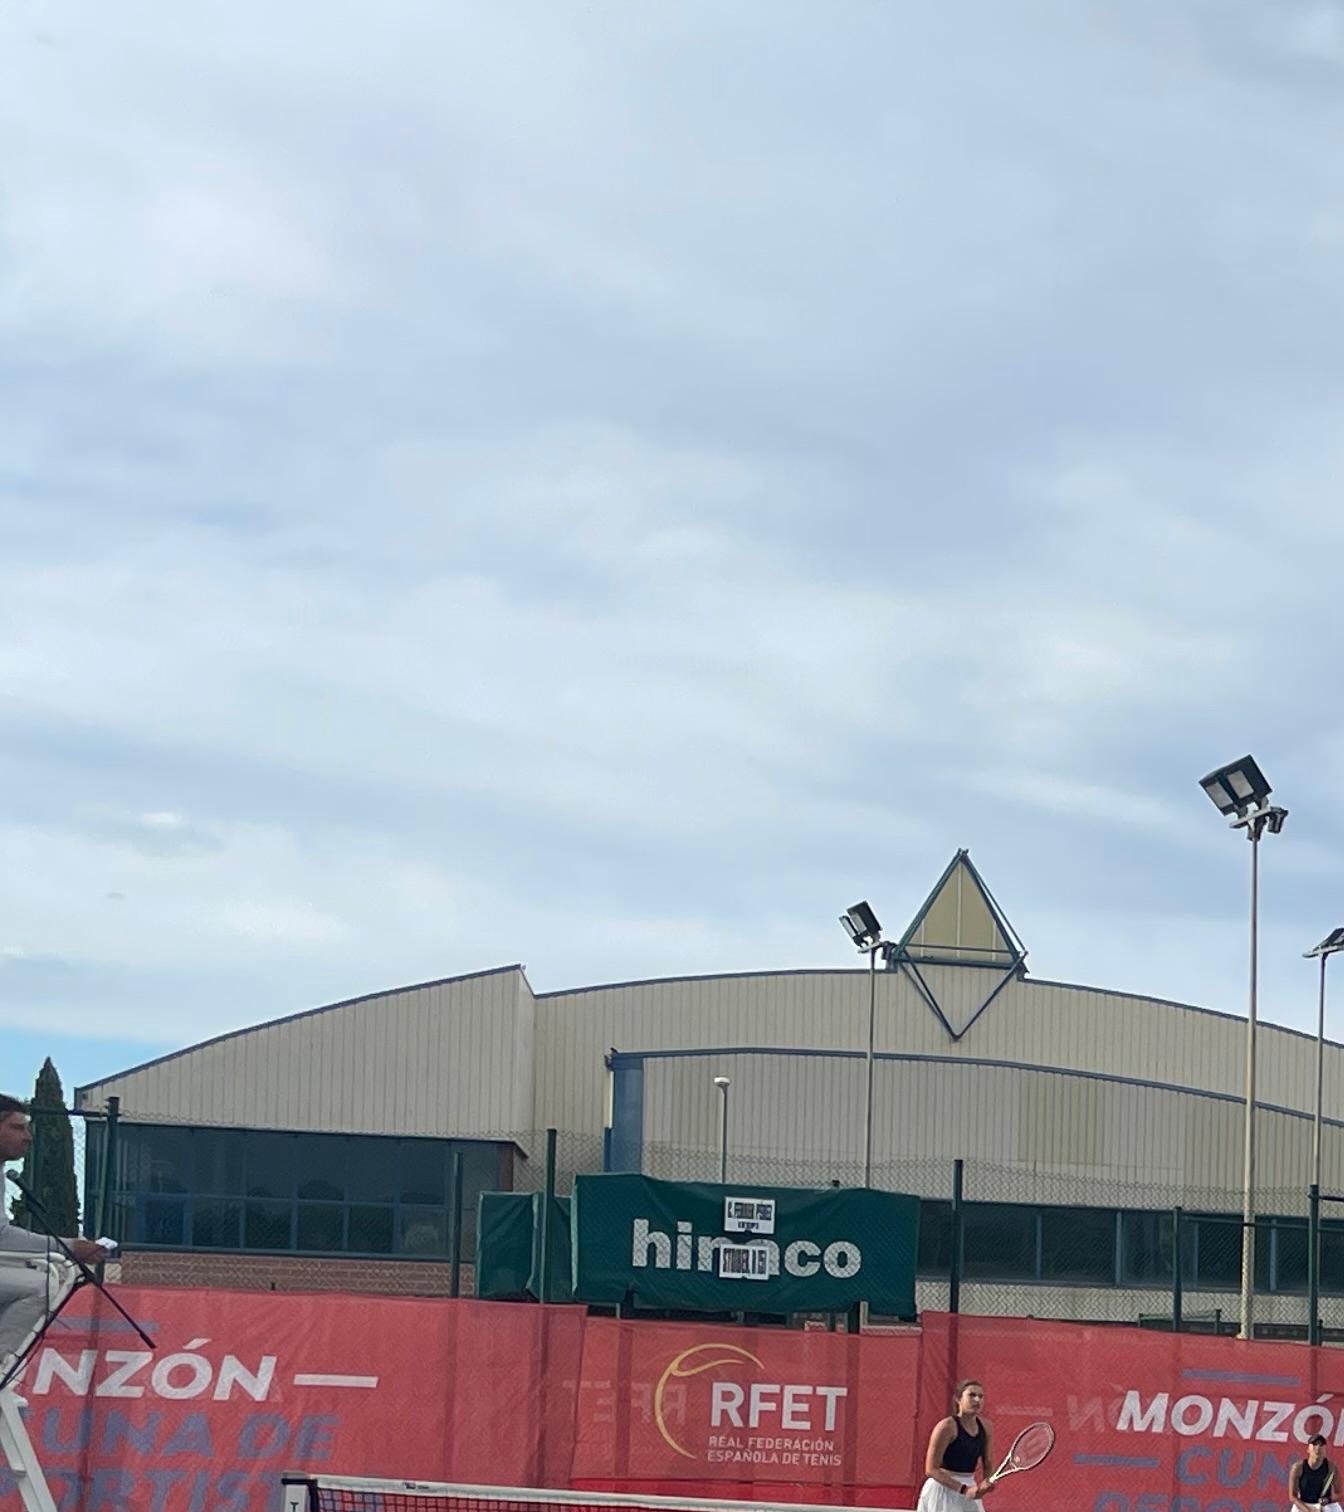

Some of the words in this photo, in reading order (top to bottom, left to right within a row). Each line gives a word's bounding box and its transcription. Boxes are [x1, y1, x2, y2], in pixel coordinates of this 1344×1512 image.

[22, 1338, 278, 1402] NZÓN
[710, 1382, 848, 1432] RFET
[24, 1407, 216, 1458] UNA
[235, 1413, 341, 1462] DE
[707, 1449, 779, 1465] ESPAÑOLA
[781, 1451, 800, 1465] DE
[802, 1452, 842, 1467] TENIS
[708, 1435, 744, 1449] REAL
[748, 1436, 834, 1452] FEDERACIÓN
[1174, 1446, 1297, 1490] CUN
